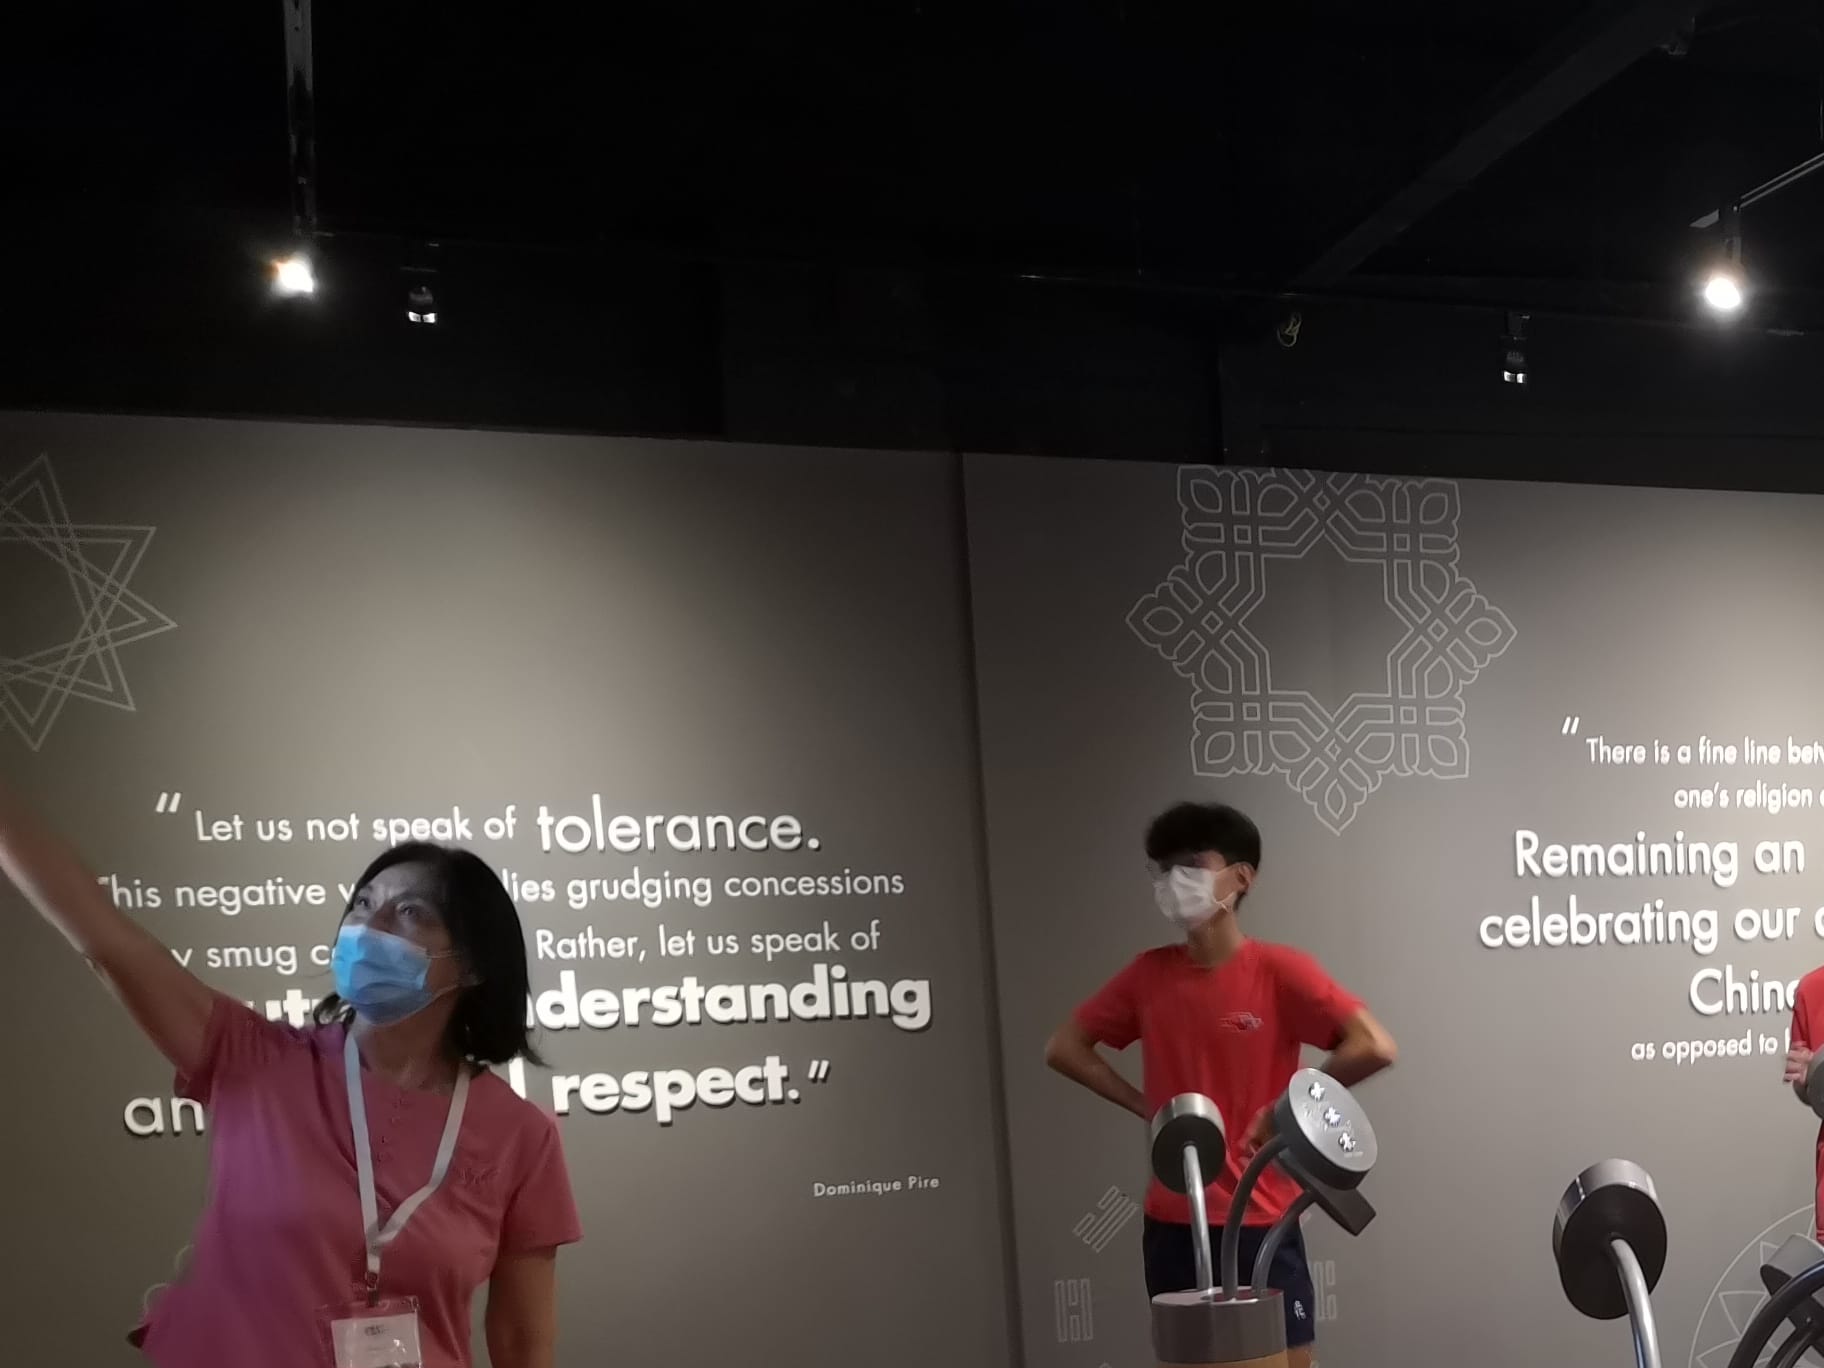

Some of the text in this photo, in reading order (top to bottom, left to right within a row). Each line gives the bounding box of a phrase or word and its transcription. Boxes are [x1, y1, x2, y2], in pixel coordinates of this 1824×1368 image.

[1586, 735, 1646, 764] There
[1654, 739, 1670, 764] is
[1677, 745, 1692, 764] a
[1698, 735, 1738, 765] fine
[1744, 736, 1781, 765] line
[1674, 781, 1730, 809] one's
[1736, 779, 1813, 815] religion
[196, 793, 819, 853] Let us not speak of tolerance.
[1515, 829, 1739, 888] Remaining
[1754, 840, 1805, 873] an
[176, 877, 327, 916] negative
[566, 866, 712, 910] grudging
[723, 868, 904, 897] concessions
[207, 945, 298, 976] smug
[535, 925, 646, 962] Rather,
[659, 924, 696, 956] let
[707, 935, 739, 955] us
[751, 921, 840, 962] speak
[850, 919, 881, 951] of
[1479, 894, 1719, 954] celebrating
[1734, 907, 1801, 940] our
[1631, 1042, 1656, 1060] as
[1662, 1029, 1752, 1065] opposed
[1758, 1033, 1778, 1054] to
[813, 1175, 939, 1197] Dominique Pire
